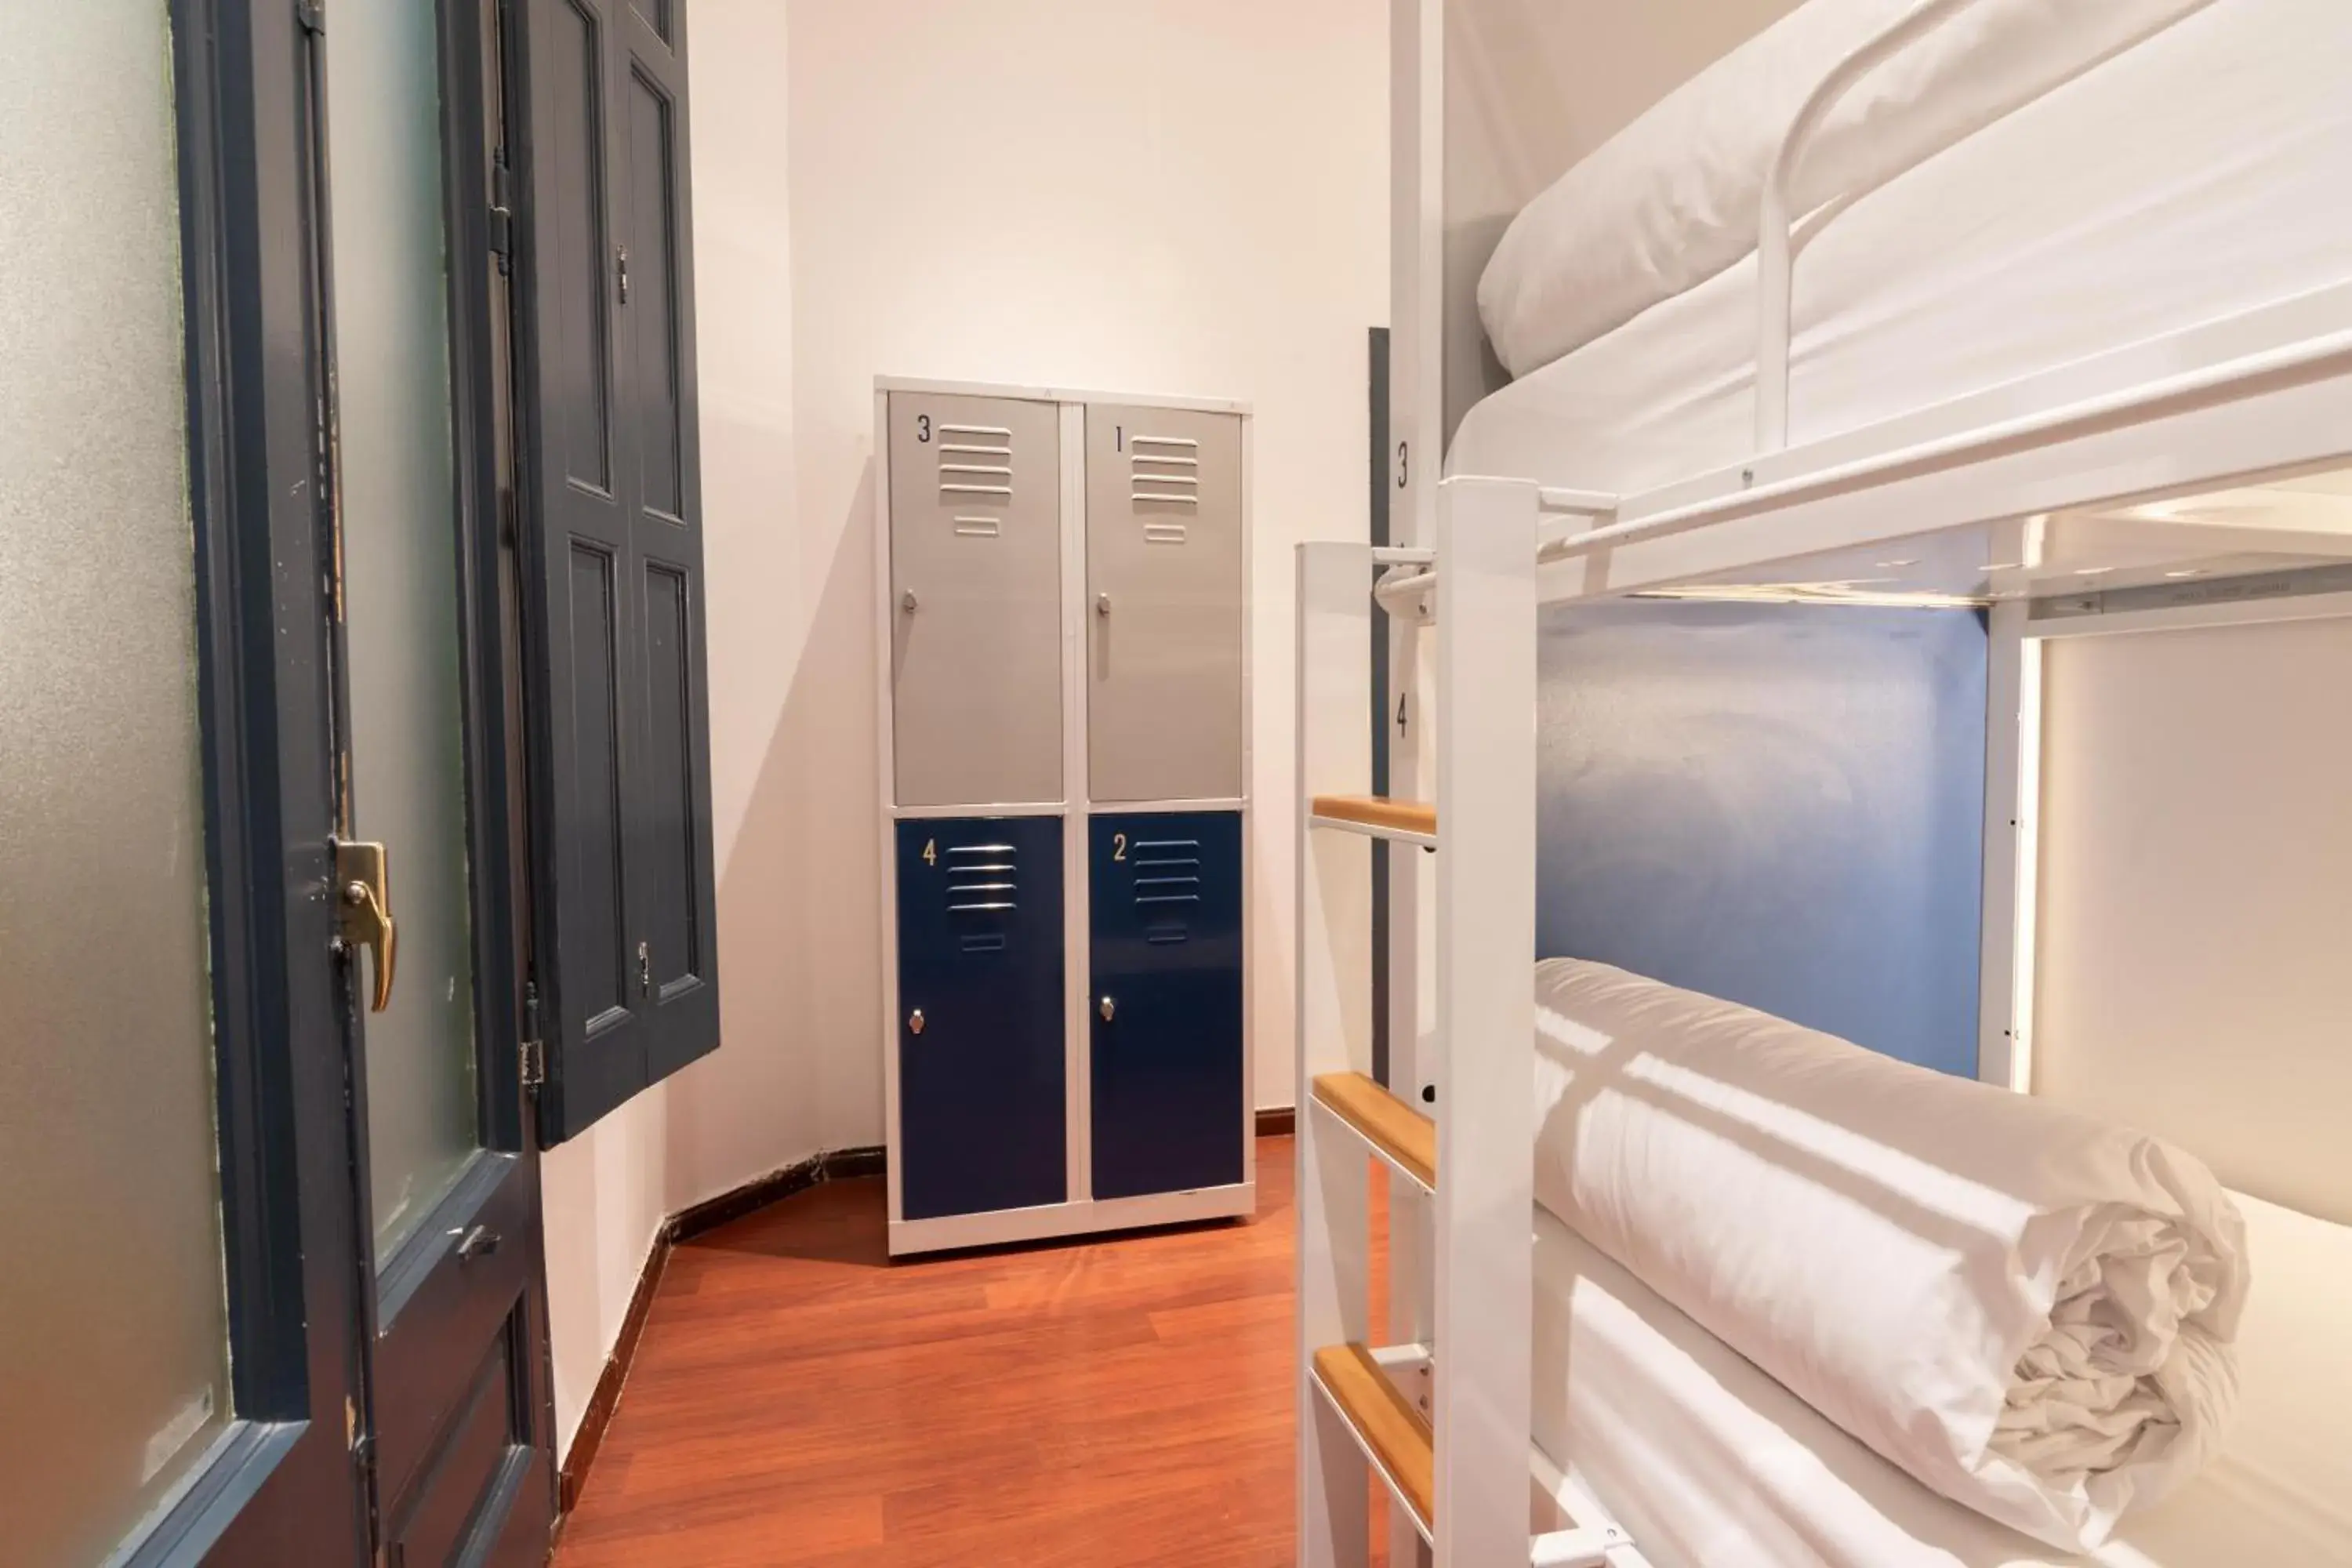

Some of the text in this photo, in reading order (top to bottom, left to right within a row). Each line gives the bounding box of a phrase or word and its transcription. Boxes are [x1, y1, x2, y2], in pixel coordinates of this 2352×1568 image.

[918, 414, 931, 443] 3
[1116, 426, 1122, 452] 1
[1398, 441, 1407, 488] 3
[1396, 691, 1408, 739] 4
[923, 838, 937, 866] 4
[1114, 833, 1126, 861] 2
